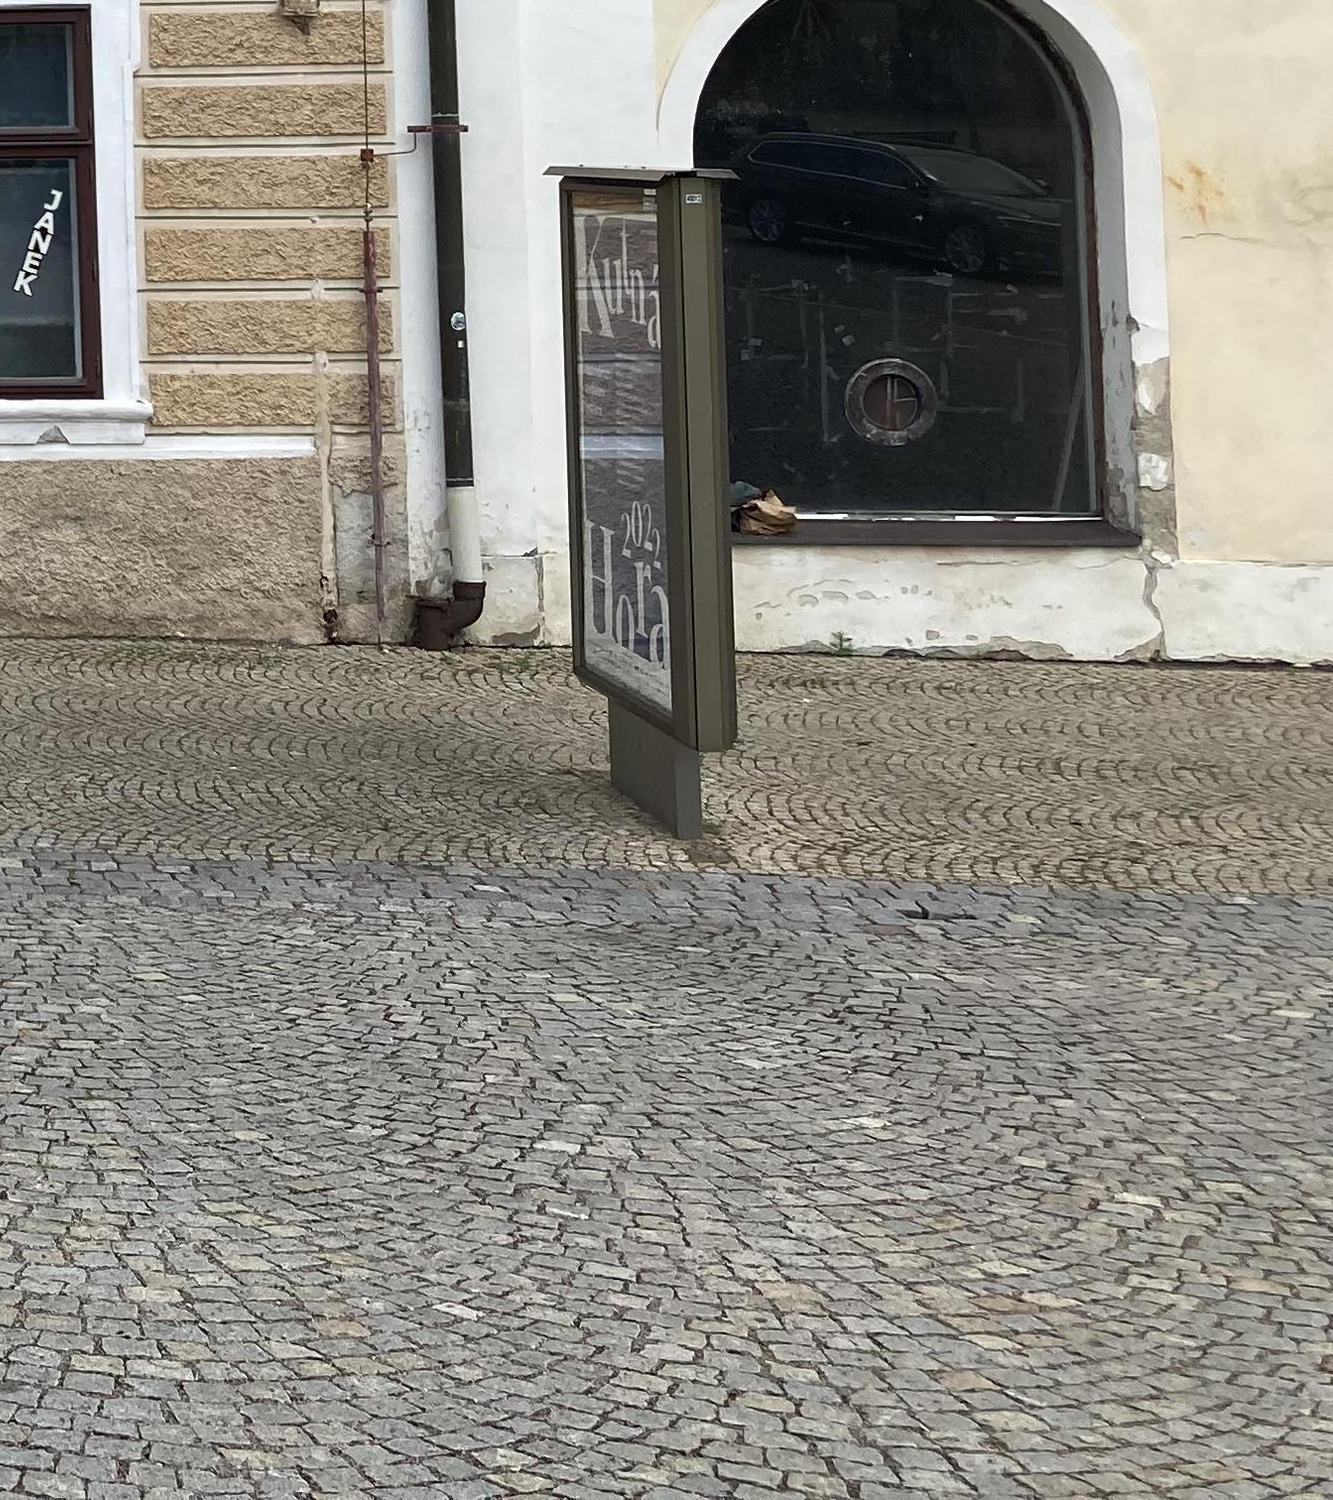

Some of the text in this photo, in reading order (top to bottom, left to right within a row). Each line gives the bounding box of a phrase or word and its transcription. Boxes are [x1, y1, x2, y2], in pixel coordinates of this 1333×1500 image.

[12, 189, 63, 297] JANEK
[621, 500, 662, 570] 2022
[584, 519, 670, 670] Hora
